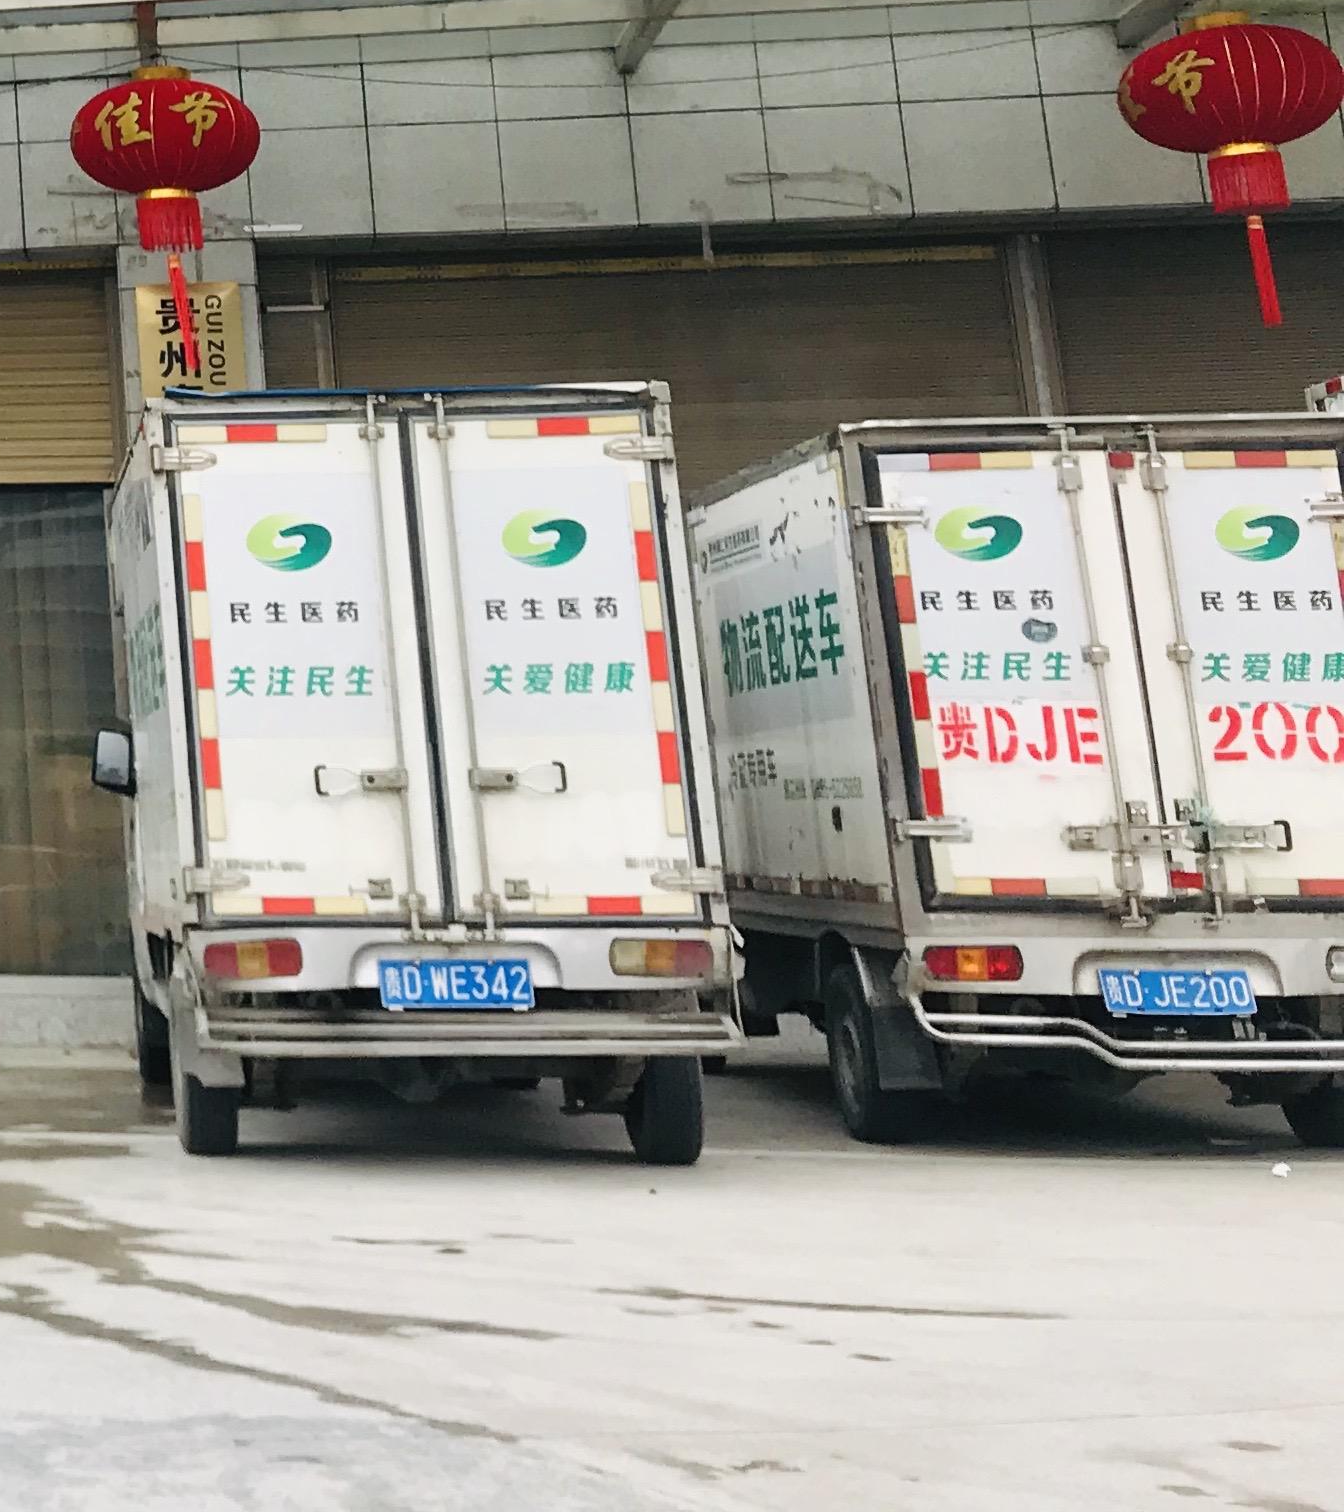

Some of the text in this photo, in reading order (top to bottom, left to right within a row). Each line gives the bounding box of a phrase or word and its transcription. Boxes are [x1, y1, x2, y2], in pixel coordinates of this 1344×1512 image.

[95, 92, 226, 151] 佳节
[230, 601, 358, 624] 民生医药
[485, 597, 618, 621] 民生医药
[920, 590, 1054, 611] 民生医药
[1201, 590, 1333, 612] 民生医药
[720, 589, 845, 697] 物流配送车
[226, 665, 374, 697] 关注民生
[483, 662, 635, 695] 关爱健康
[923, 651, 1072, 681] 关注民生
[1201, 652, 1344, 683] 关爱健康
[938, 702, 1344, 765] 贵DJE 200
